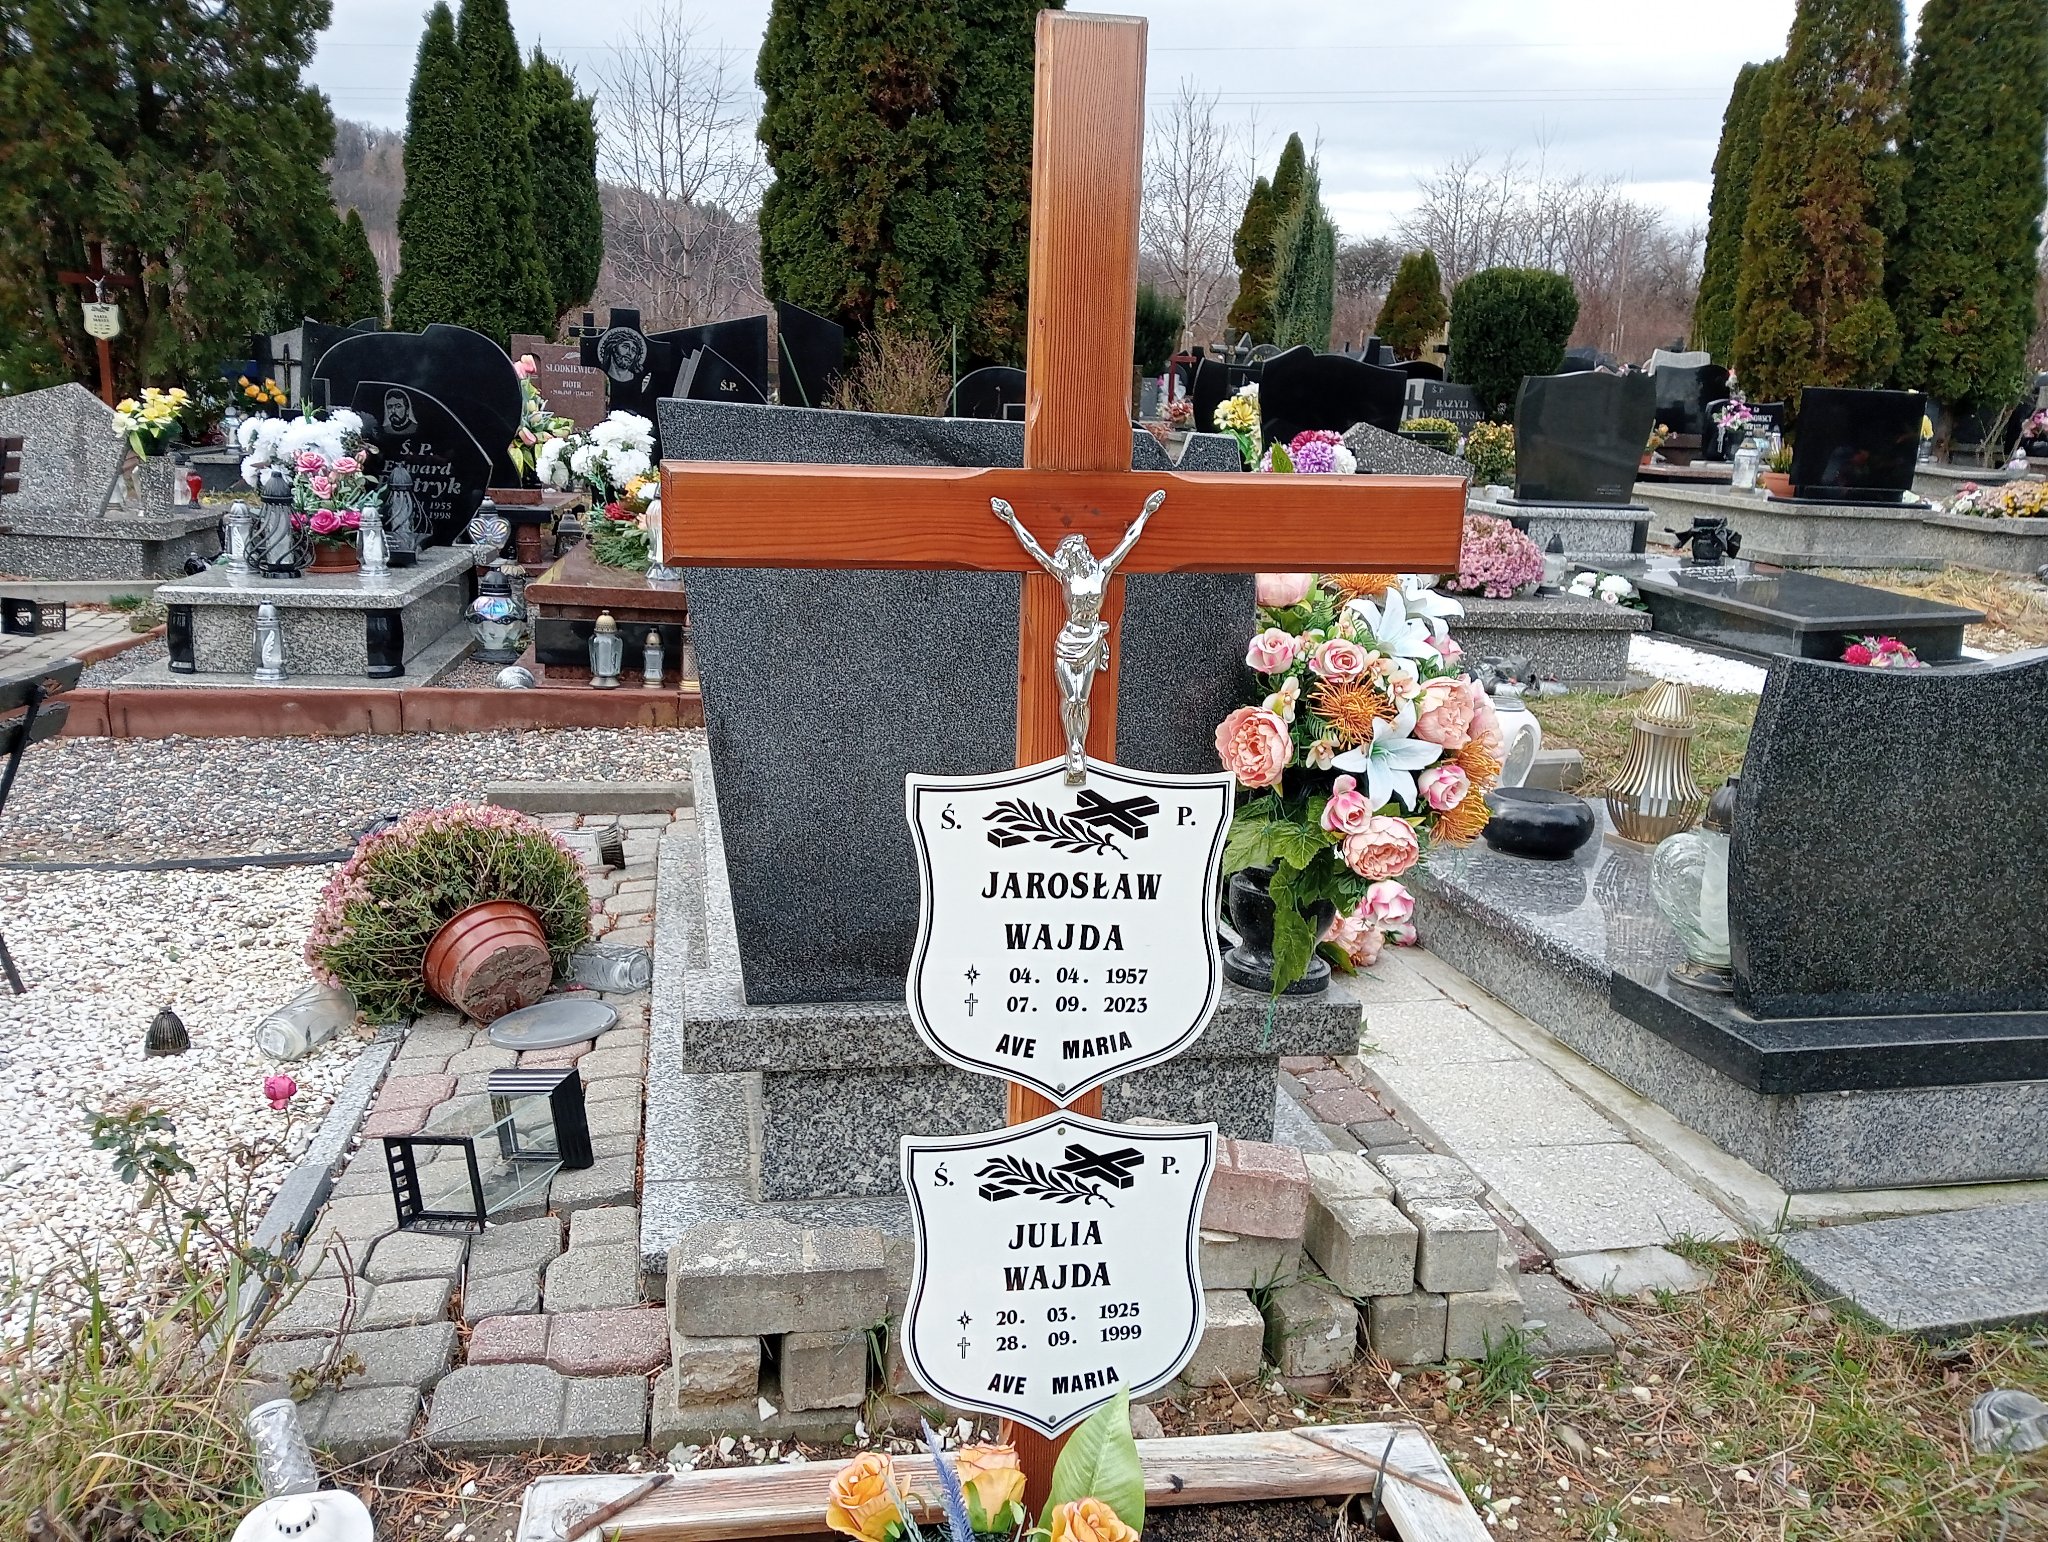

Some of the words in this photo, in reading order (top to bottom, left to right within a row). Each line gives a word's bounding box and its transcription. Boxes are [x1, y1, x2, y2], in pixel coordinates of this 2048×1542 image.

[1421, 408, 1486, 420] WRÓBLEWSKI
[428, 511, 452, 520] 1998
[429, 501, 453, 510] 1955
[941, 802, 962, 830] Ś.
[1177, 806, 1196, 826] P.
[981, 871, 1163, 900] JAROSŁAW
[1004, 923, 1125, 951] WAJDA
[1009, 967, 1040, 984] 04.
[1056, 967, 1089, 984] 04.
[1105, 968, 1148, 985] 1957
[1006, 996, 1038, 1013] 07.
[1055, 995, 1088, 1013] 09.
[1103, 996, 1148, 1014] 2023
[995, 1033, 1037, 1059] AVE
[1062, 1030, 1133, 1060] MARIA
[934, 1161, 955, 1187] Ś.
[1161, 1156, 1180, 1175] P.
[1008, 1220, 1103, 1250] JULIA
[1003, 1261, 1112, 1292] WAJDA
[996, 1309, 1025, 1326] 20.
[1046, 1306, 1076, 1323] 03.
[1099, 1302, 1140, 1319] 1925
[996, 1335, 1027, 1352] 28.
[1047, 1330, 1077, 1347] 09.
[1100, 1324, 1142, 1343] 1999
[987, 1373, 1027, 1396] AVE
[1052, 1366, 1120, 1395] MARIA
